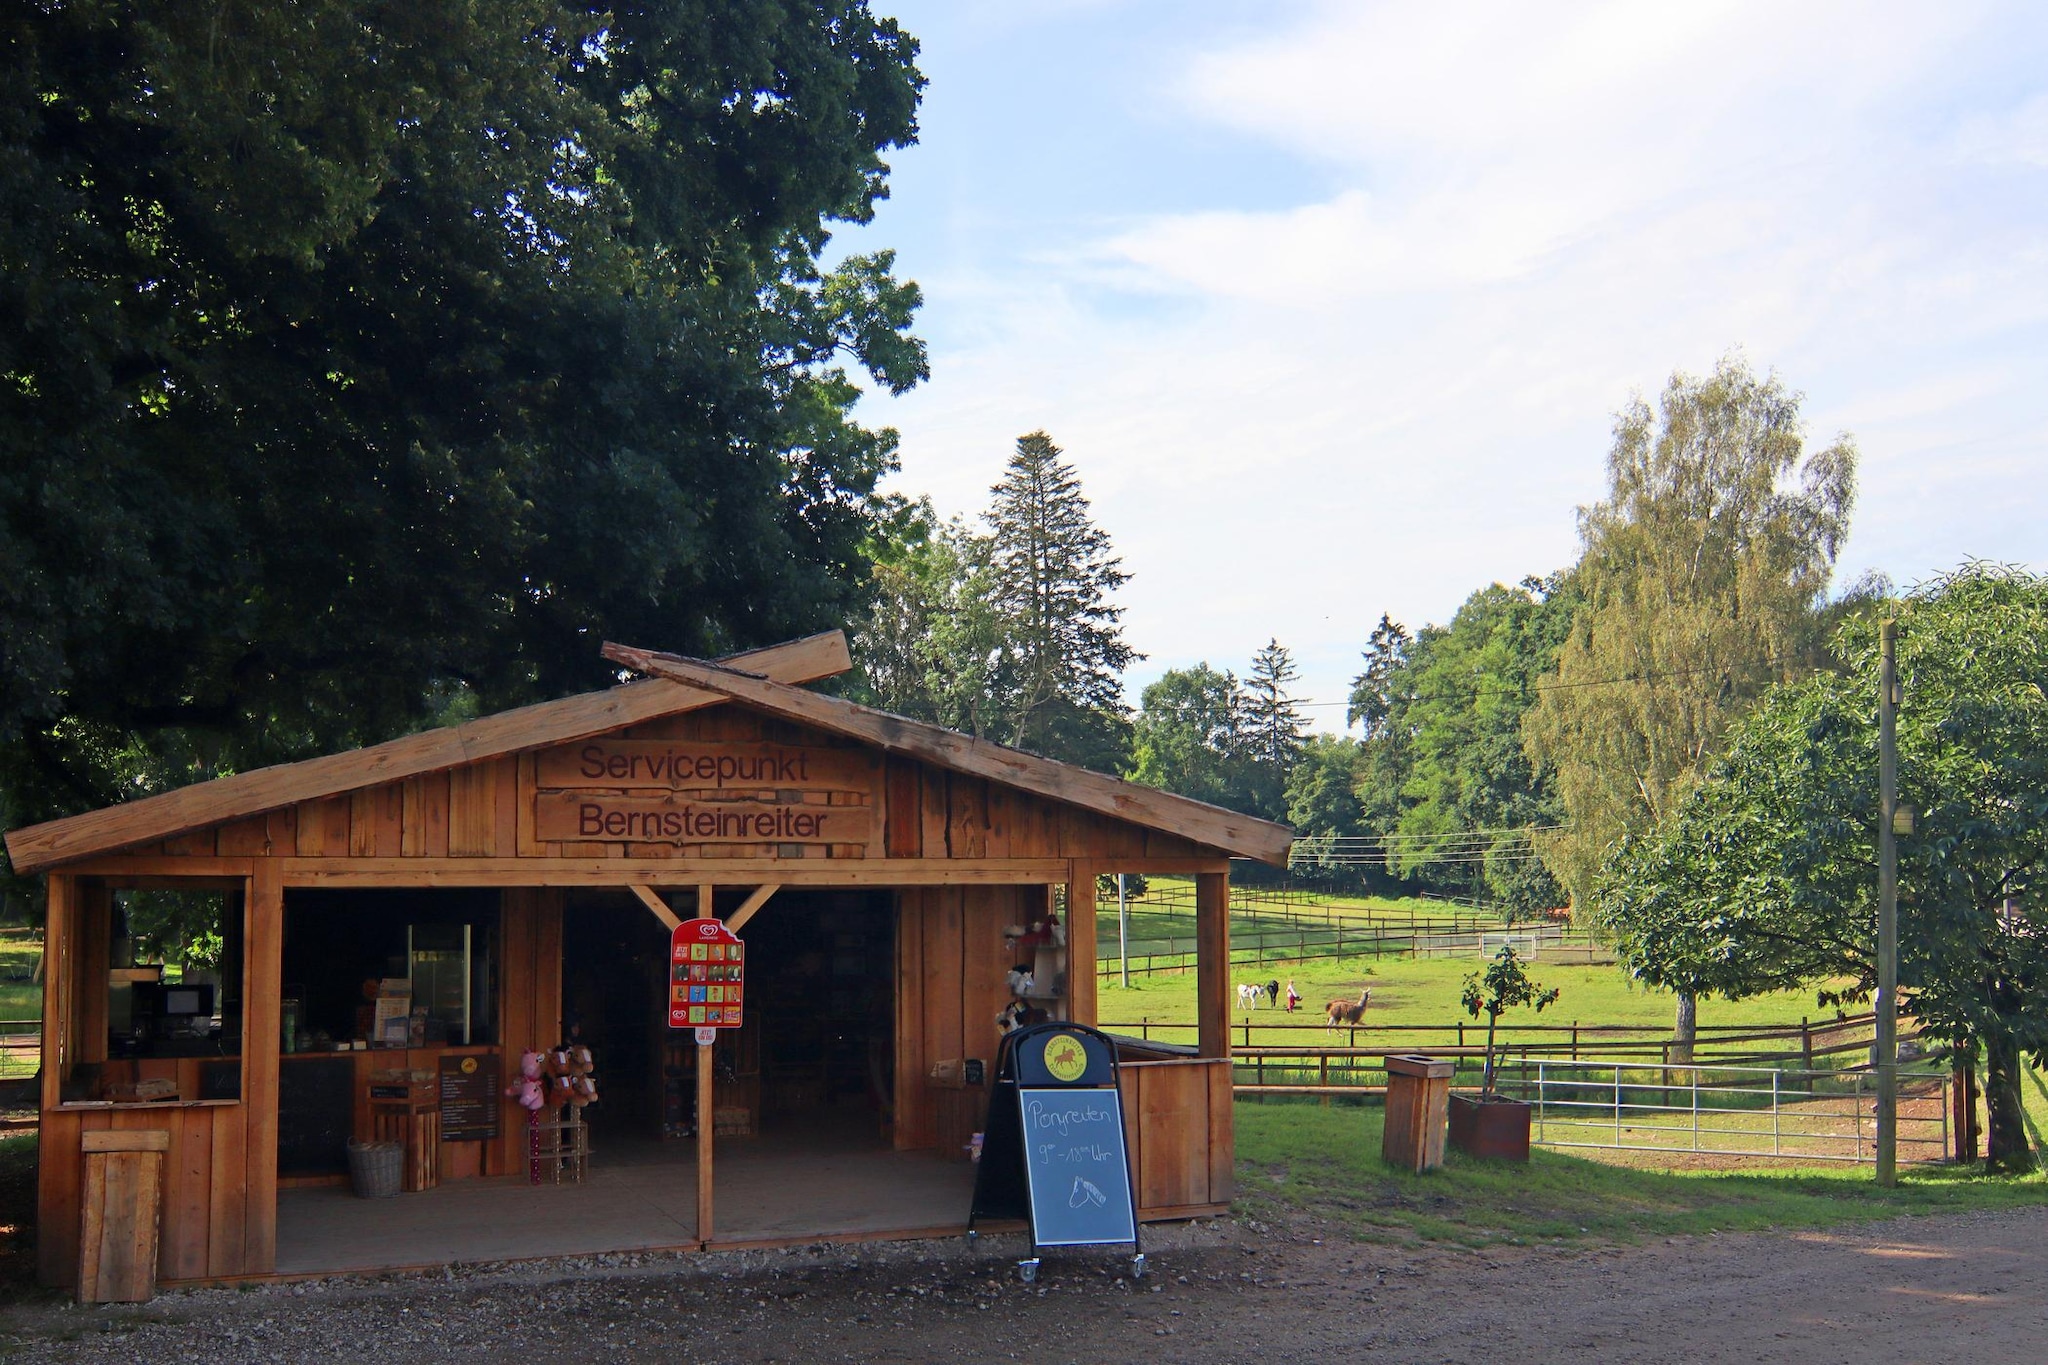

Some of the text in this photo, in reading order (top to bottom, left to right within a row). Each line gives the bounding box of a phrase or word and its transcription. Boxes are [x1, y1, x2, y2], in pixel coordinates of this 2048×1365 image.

[581, 746, 809, 788] Servicepunkt
[579, 805, 827, 837] Bernsteinreiter
[1028, 1101, 1111, 1136] Ponyreiten
[1091, 1144, 1112, 1161] Uhr
